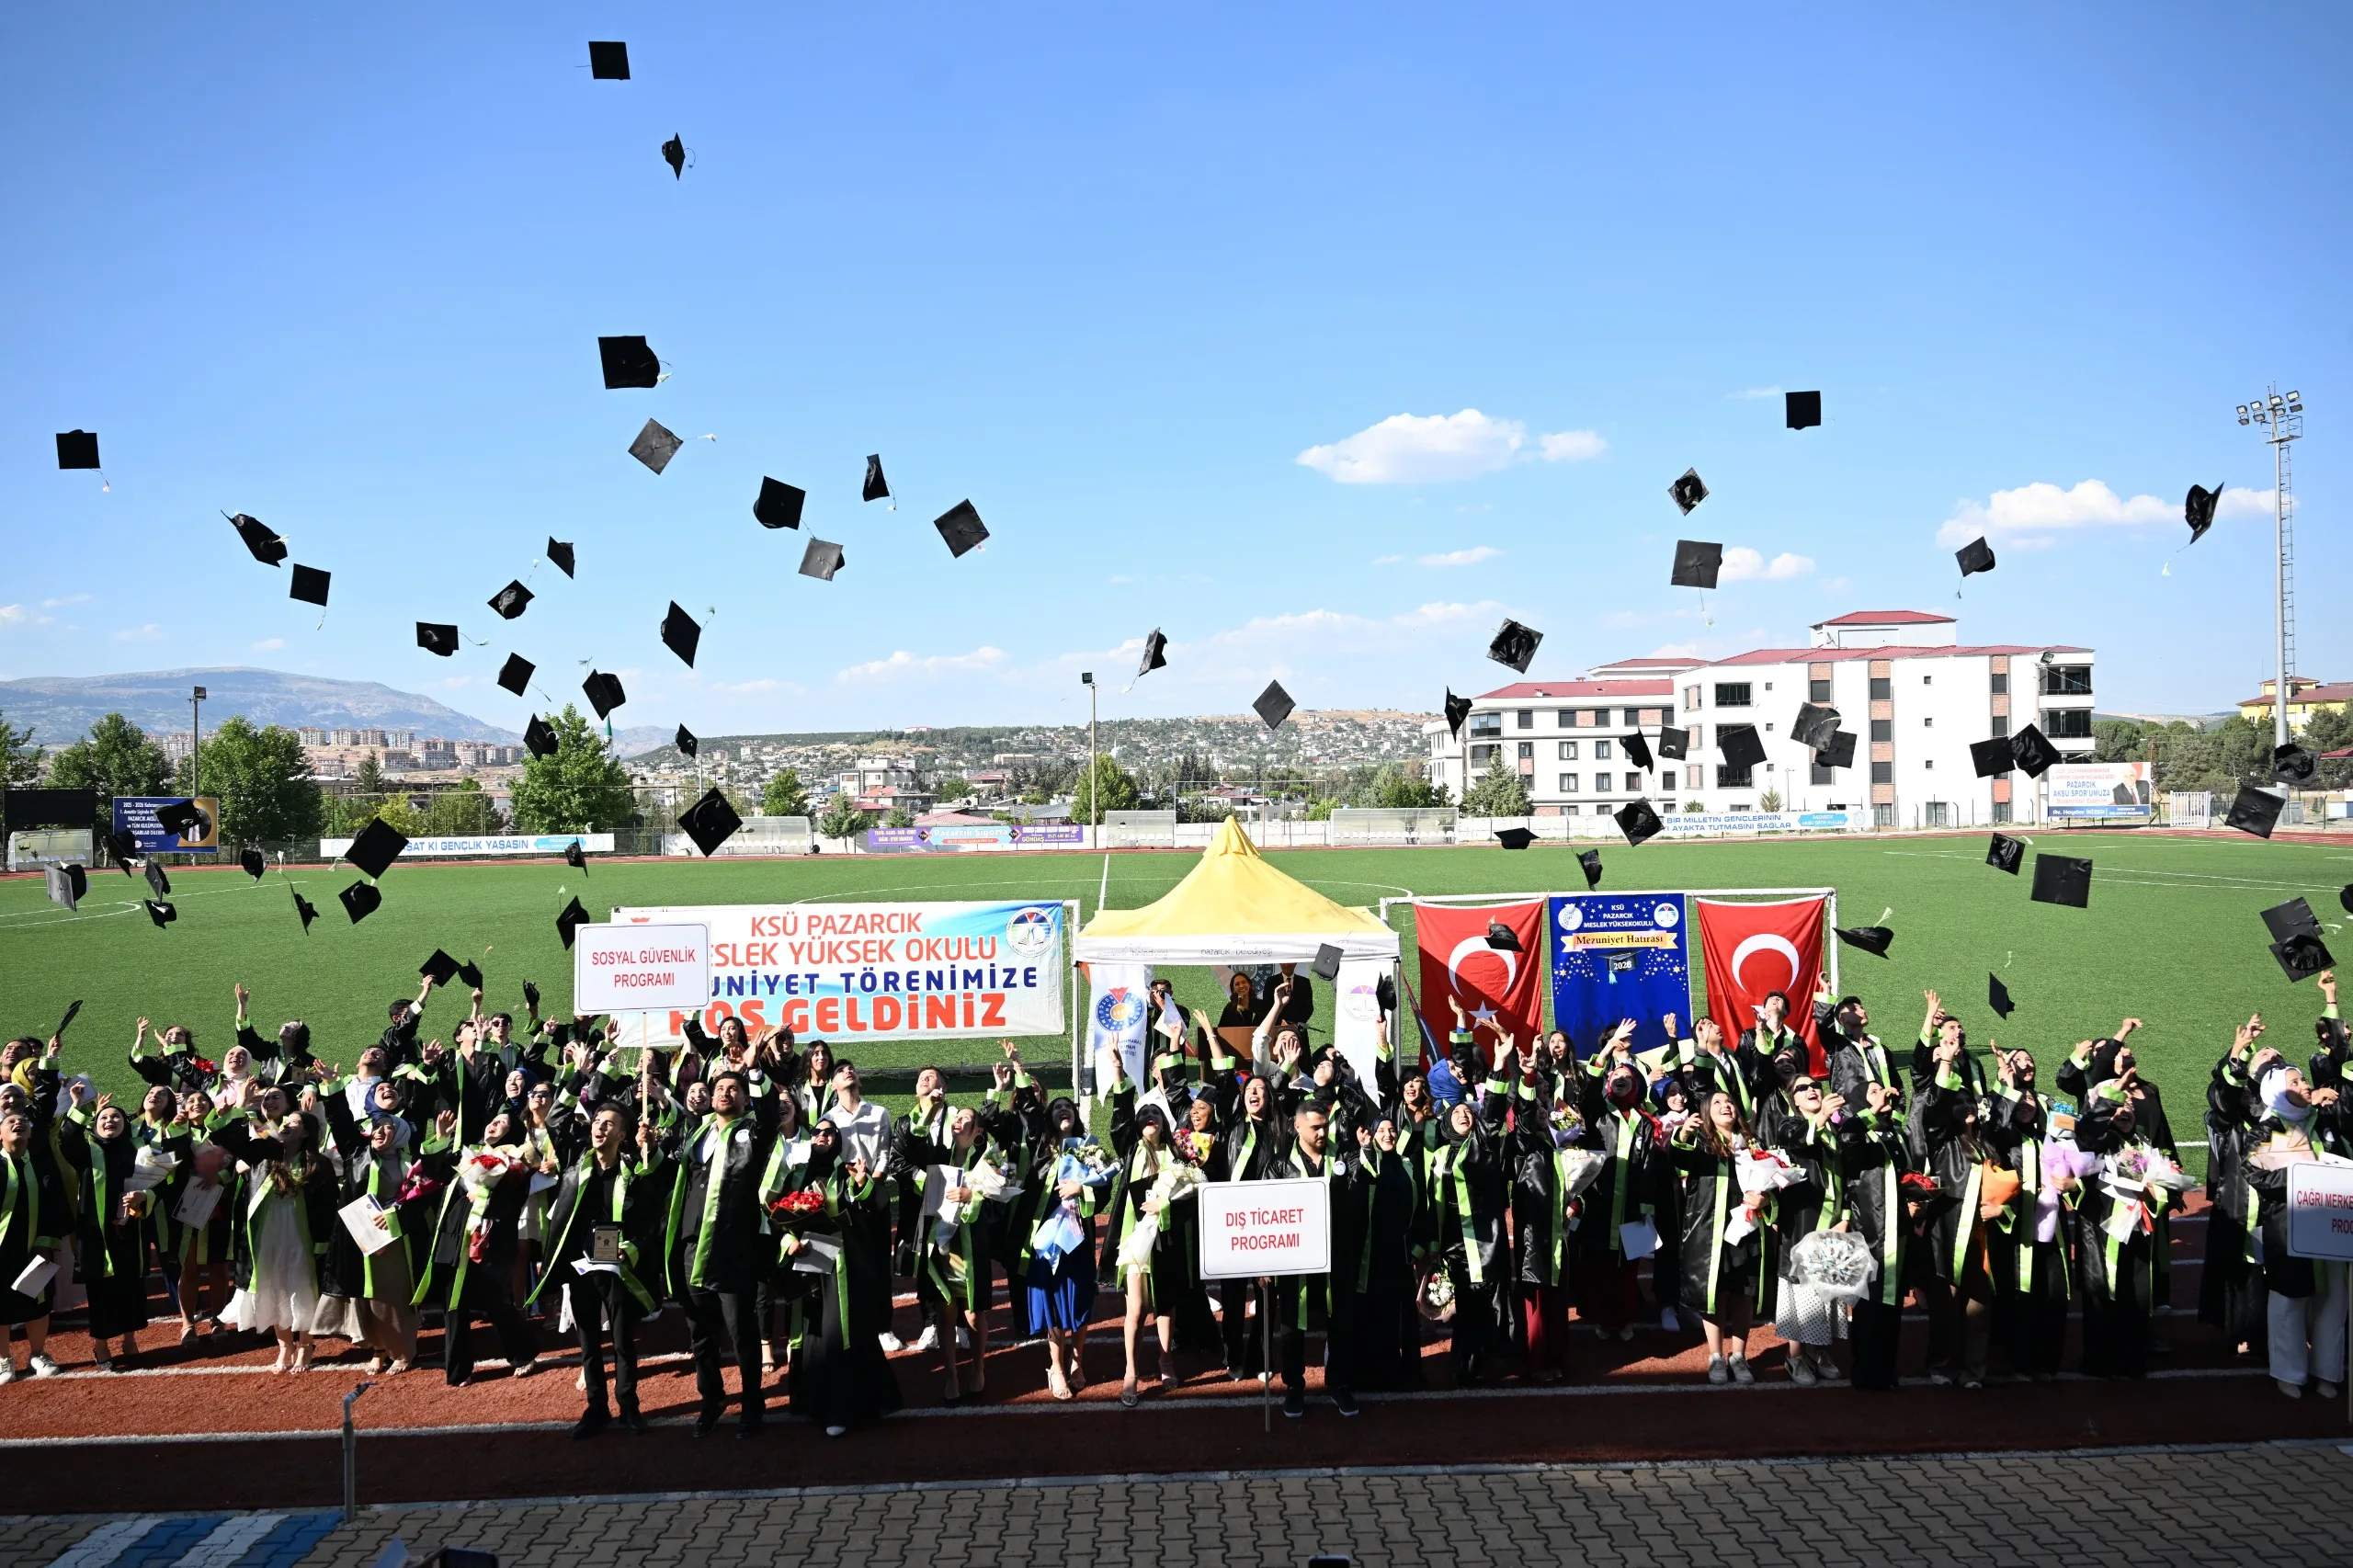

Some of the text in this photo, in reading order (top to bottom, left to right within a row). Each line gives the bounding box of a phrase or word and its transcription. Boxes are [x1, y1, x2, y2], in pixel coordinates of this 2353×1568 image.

[975, 828, 1007, 837] Sigorta
[1757, 821, 1790, 829] SAĞLAR
[404, 838, 529, 853] ŞAT Kİ GENÇLİK YAŞASIN
[751, 911, 922, 937] KSÜ PAZARCIK
[1576, 935, 1664, 945] Mezuniyet Hatırası
[592, 946, 695, 965] SOSYAL GÜVENLİK
[789, 936, 895, 965] YÜKSEK
[905, 936, 996, 961] OKULU
[614, 972, 675, 987] PROGRAMI
[840, 963, 1037, 994] TÖRENİMİZE
[781, 993, 1006, 1033] GELDİNİZ
[2297, 1188, 2353, 1210] ÇAĞRI MERKE
[1226, 1208, 1303, 1230] DIŞ TİCARET
[1232, 1233, 1300, 1251] PROGRAMI
